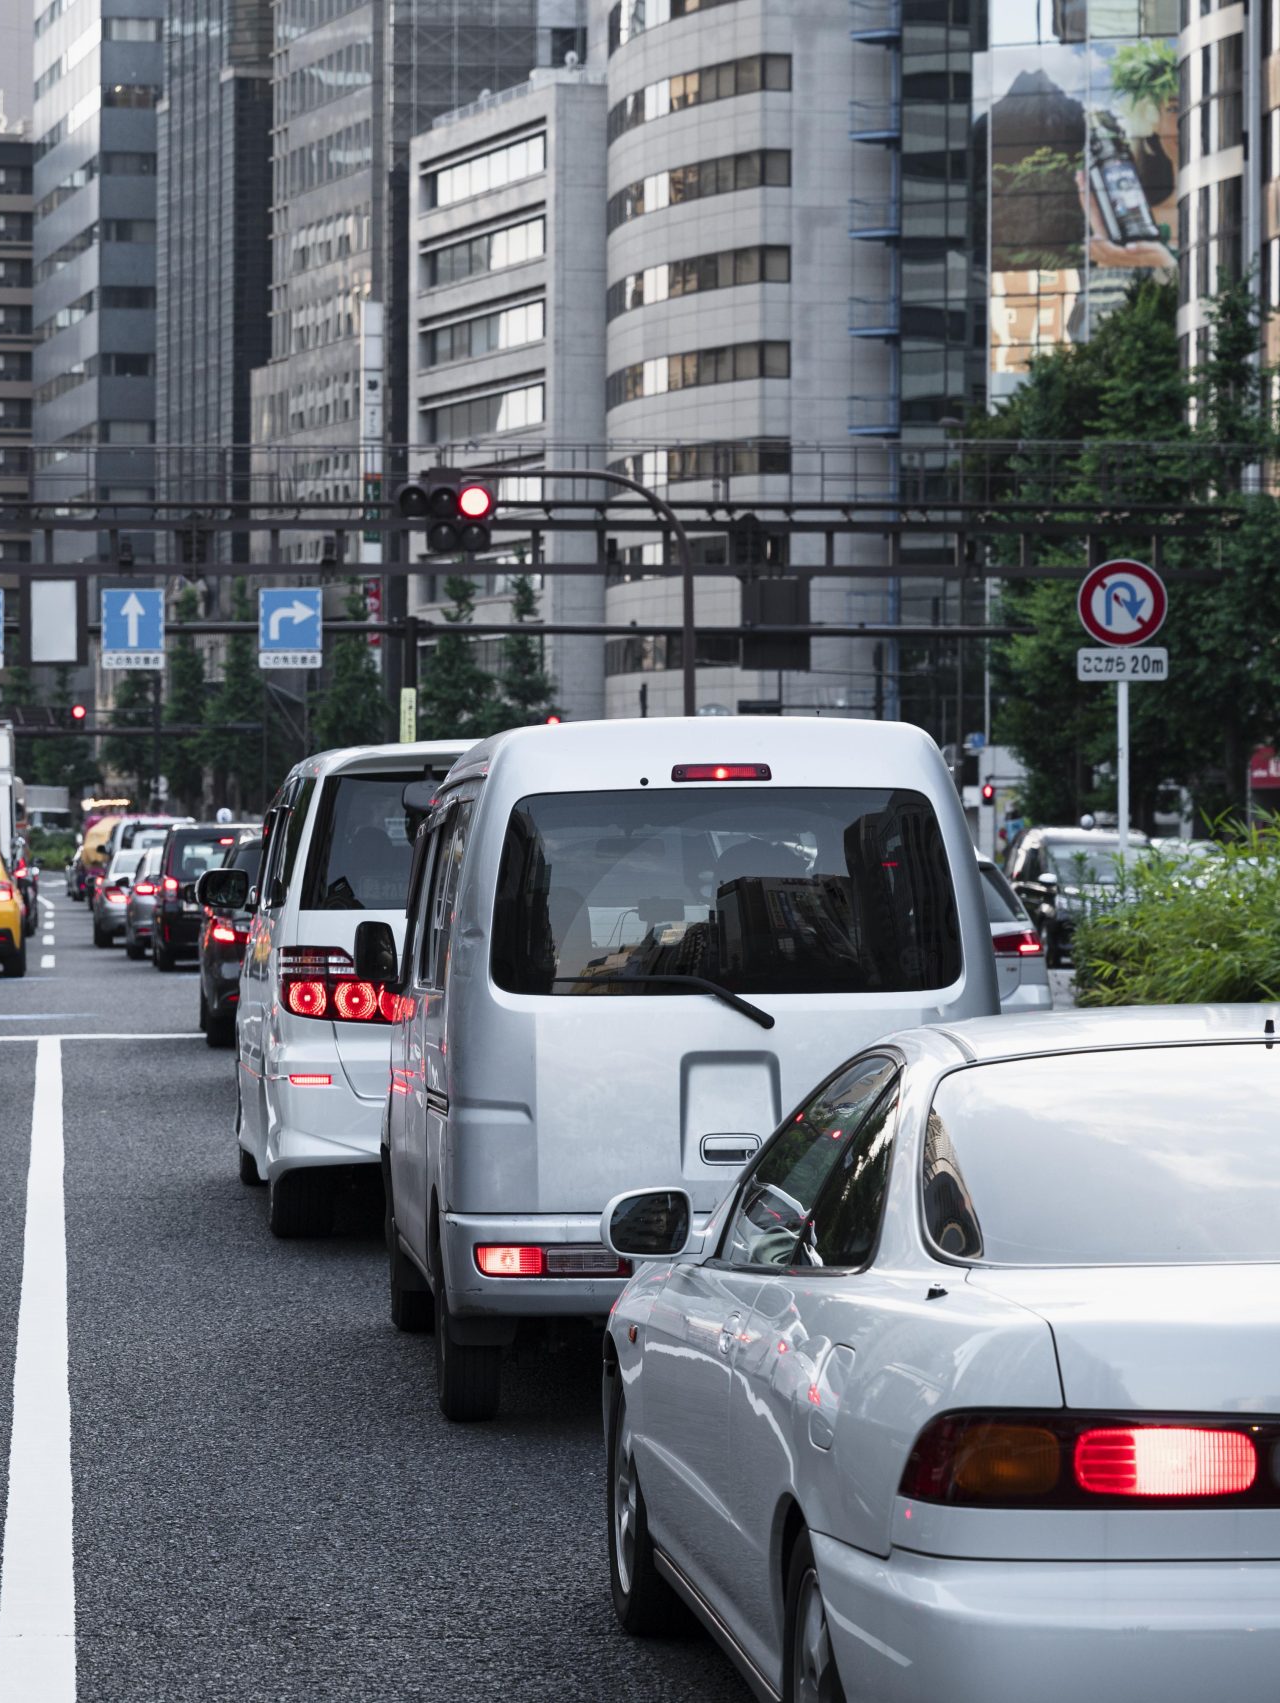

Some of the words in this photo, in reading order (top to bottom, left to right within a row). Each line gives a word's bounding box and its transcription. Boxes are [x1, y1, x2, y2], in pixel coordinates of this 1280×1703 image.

[1083, 656, 1126, 673] ここから
[1131, 655, 1164, 674] 20m
